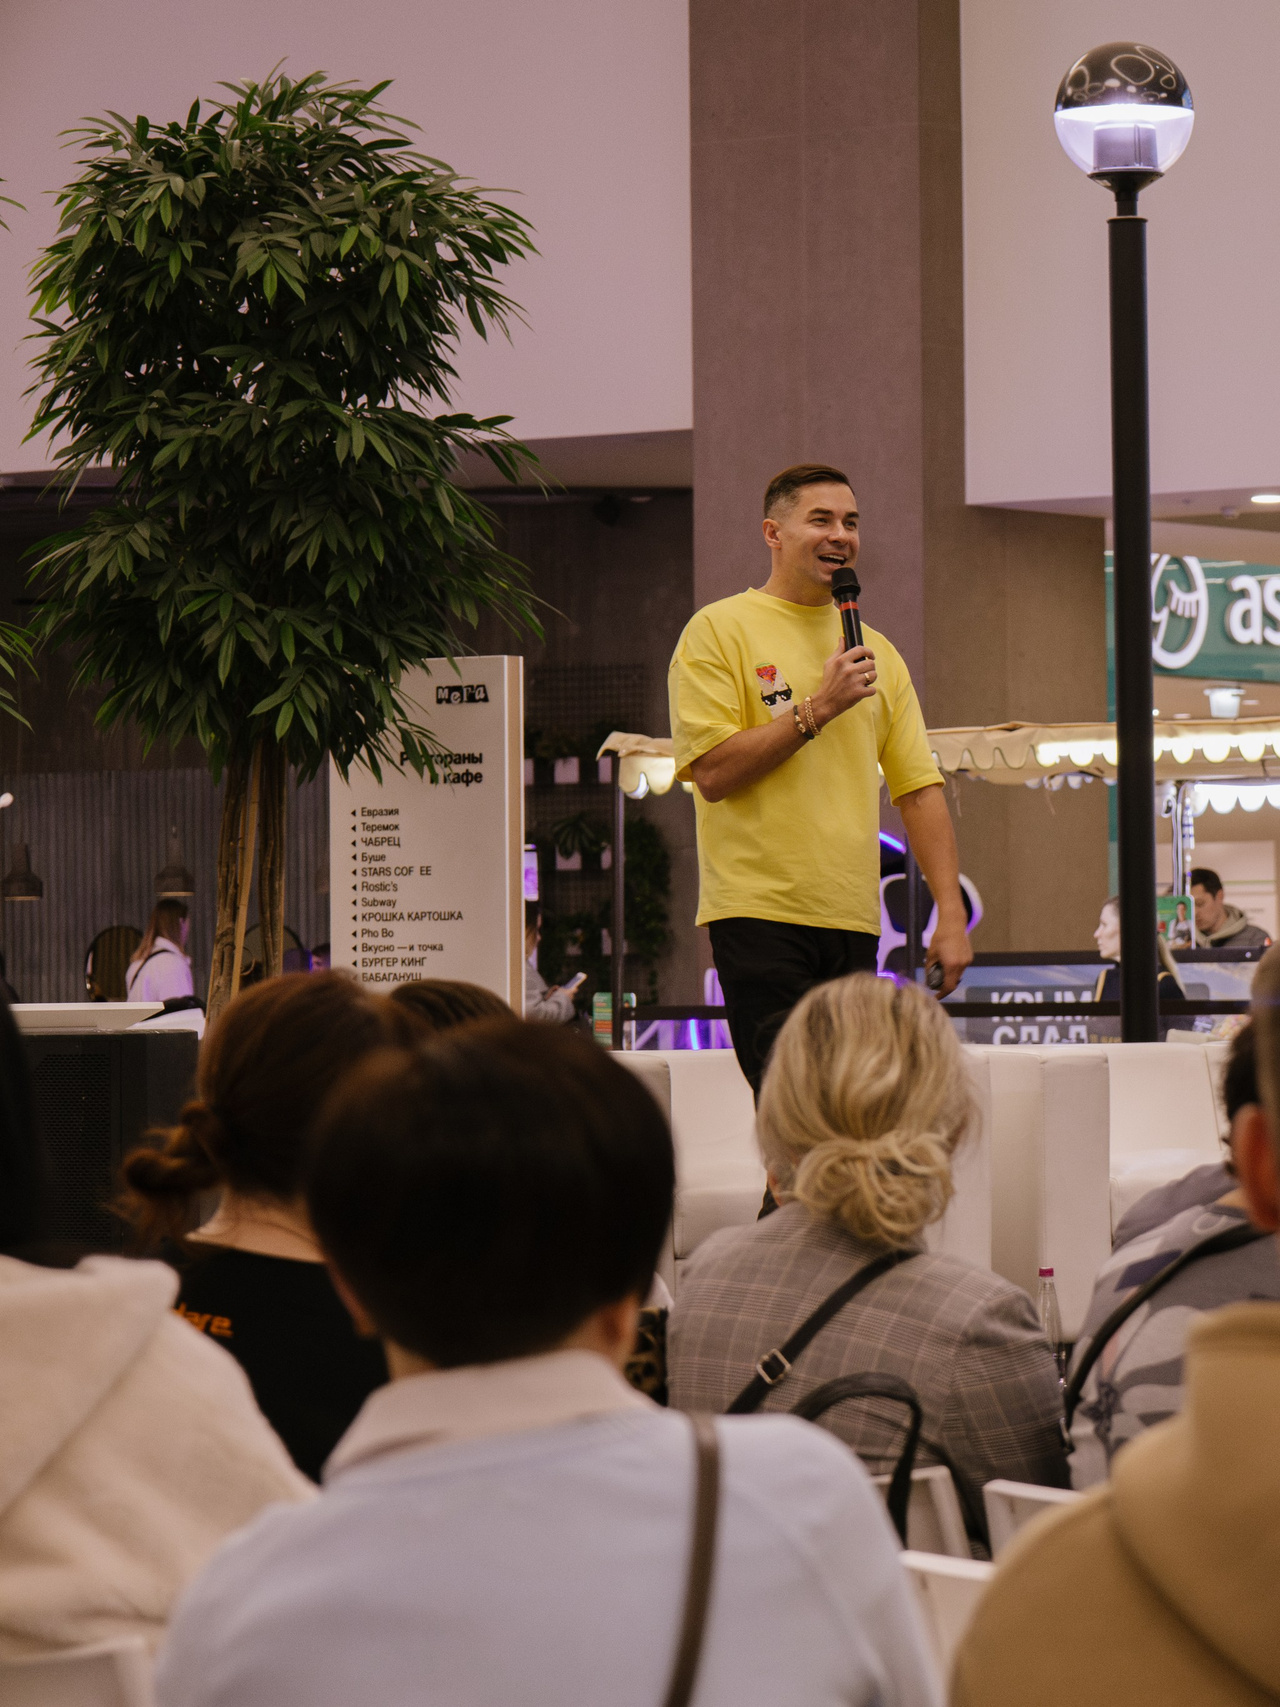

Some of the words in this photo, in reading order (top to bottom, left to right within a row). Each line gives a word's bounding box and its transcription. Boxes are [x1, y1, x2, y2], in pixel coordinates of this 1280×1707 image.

[399, 751, 484, 768] Ртораны
[360, 807, 400, 819] Евразия
[360, 822, 400, 834] Теремок
[360, 837, 401, 848] ЧАБРЕЦ
[361, 852, 387, 864] Буше
[361, 867, 392, 877] STARS
[361, 881, 398, 892] Rostic's
[361, 897, 397, 909] Subway
[361, 911, 405, 922] КРОШКА
[407, 911, 464, 921] КАРТОШКА
[361, 928, 379, 938] Pho
[381, 928, 394, 938] Bo
[361, 943, 395, 954] Вкусно
[417, 943, 444, 952] точка
[361, 957, 398, 968] БУРГЕР
[400, 957, 427, 967] КИНГ
